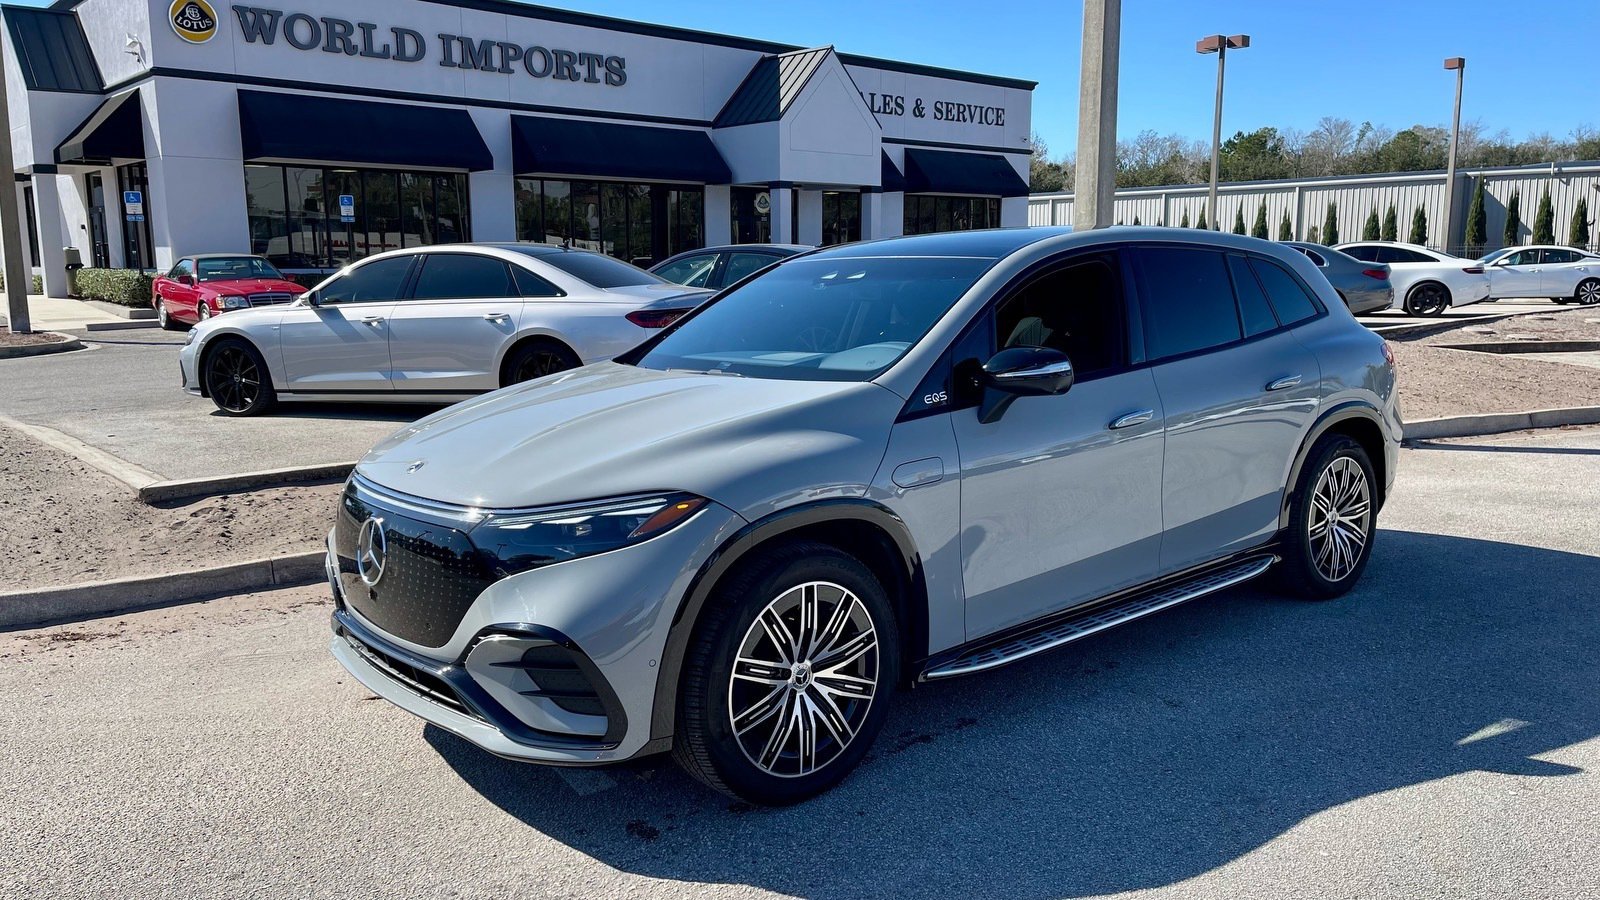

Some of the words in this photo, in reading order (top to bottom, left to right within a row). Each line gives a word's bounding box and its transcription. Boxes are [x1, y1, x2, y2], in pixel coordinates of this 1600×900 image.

[177, 16, 212, 29] LOTUS
[232, 5, 427, 63] WORLD
[438, 33, 628, 87] IMPORTS
[861, 91, 905, 116] LES
[912, 98, 926, 119] &
[933, 100, 1006, 127] SERVICE
[924, 391, 948, 404] EQS
